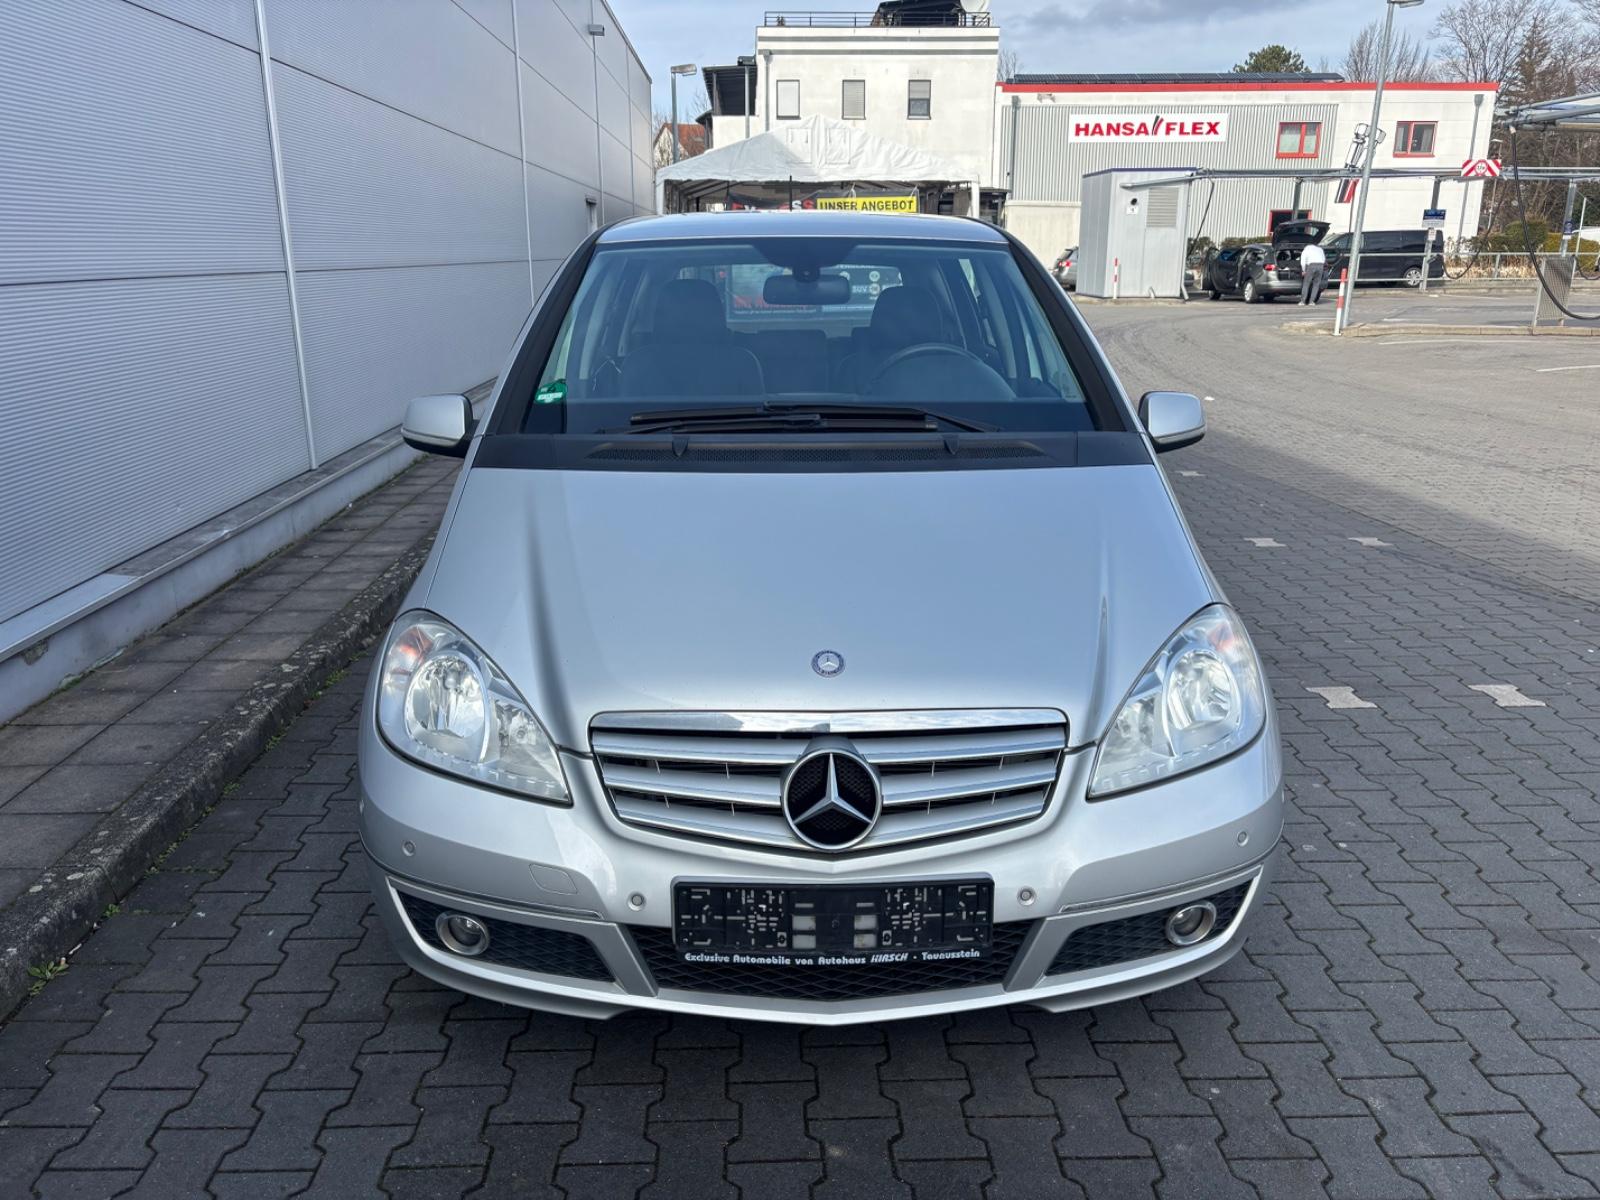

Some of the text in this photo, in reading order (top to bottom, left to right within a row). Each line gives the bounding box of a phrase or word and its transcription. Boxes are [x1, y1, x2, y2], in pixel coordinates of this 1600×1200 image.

[1074, 121, 1220, 136] HANSA FLEX
[820, 201, 857, 210] UNSER
[861, 199, 914, 211] ANGEBOT
[685, 948, 981, 966] Exclusive Automobile von Autohaus HIRSCH Taunusstein
